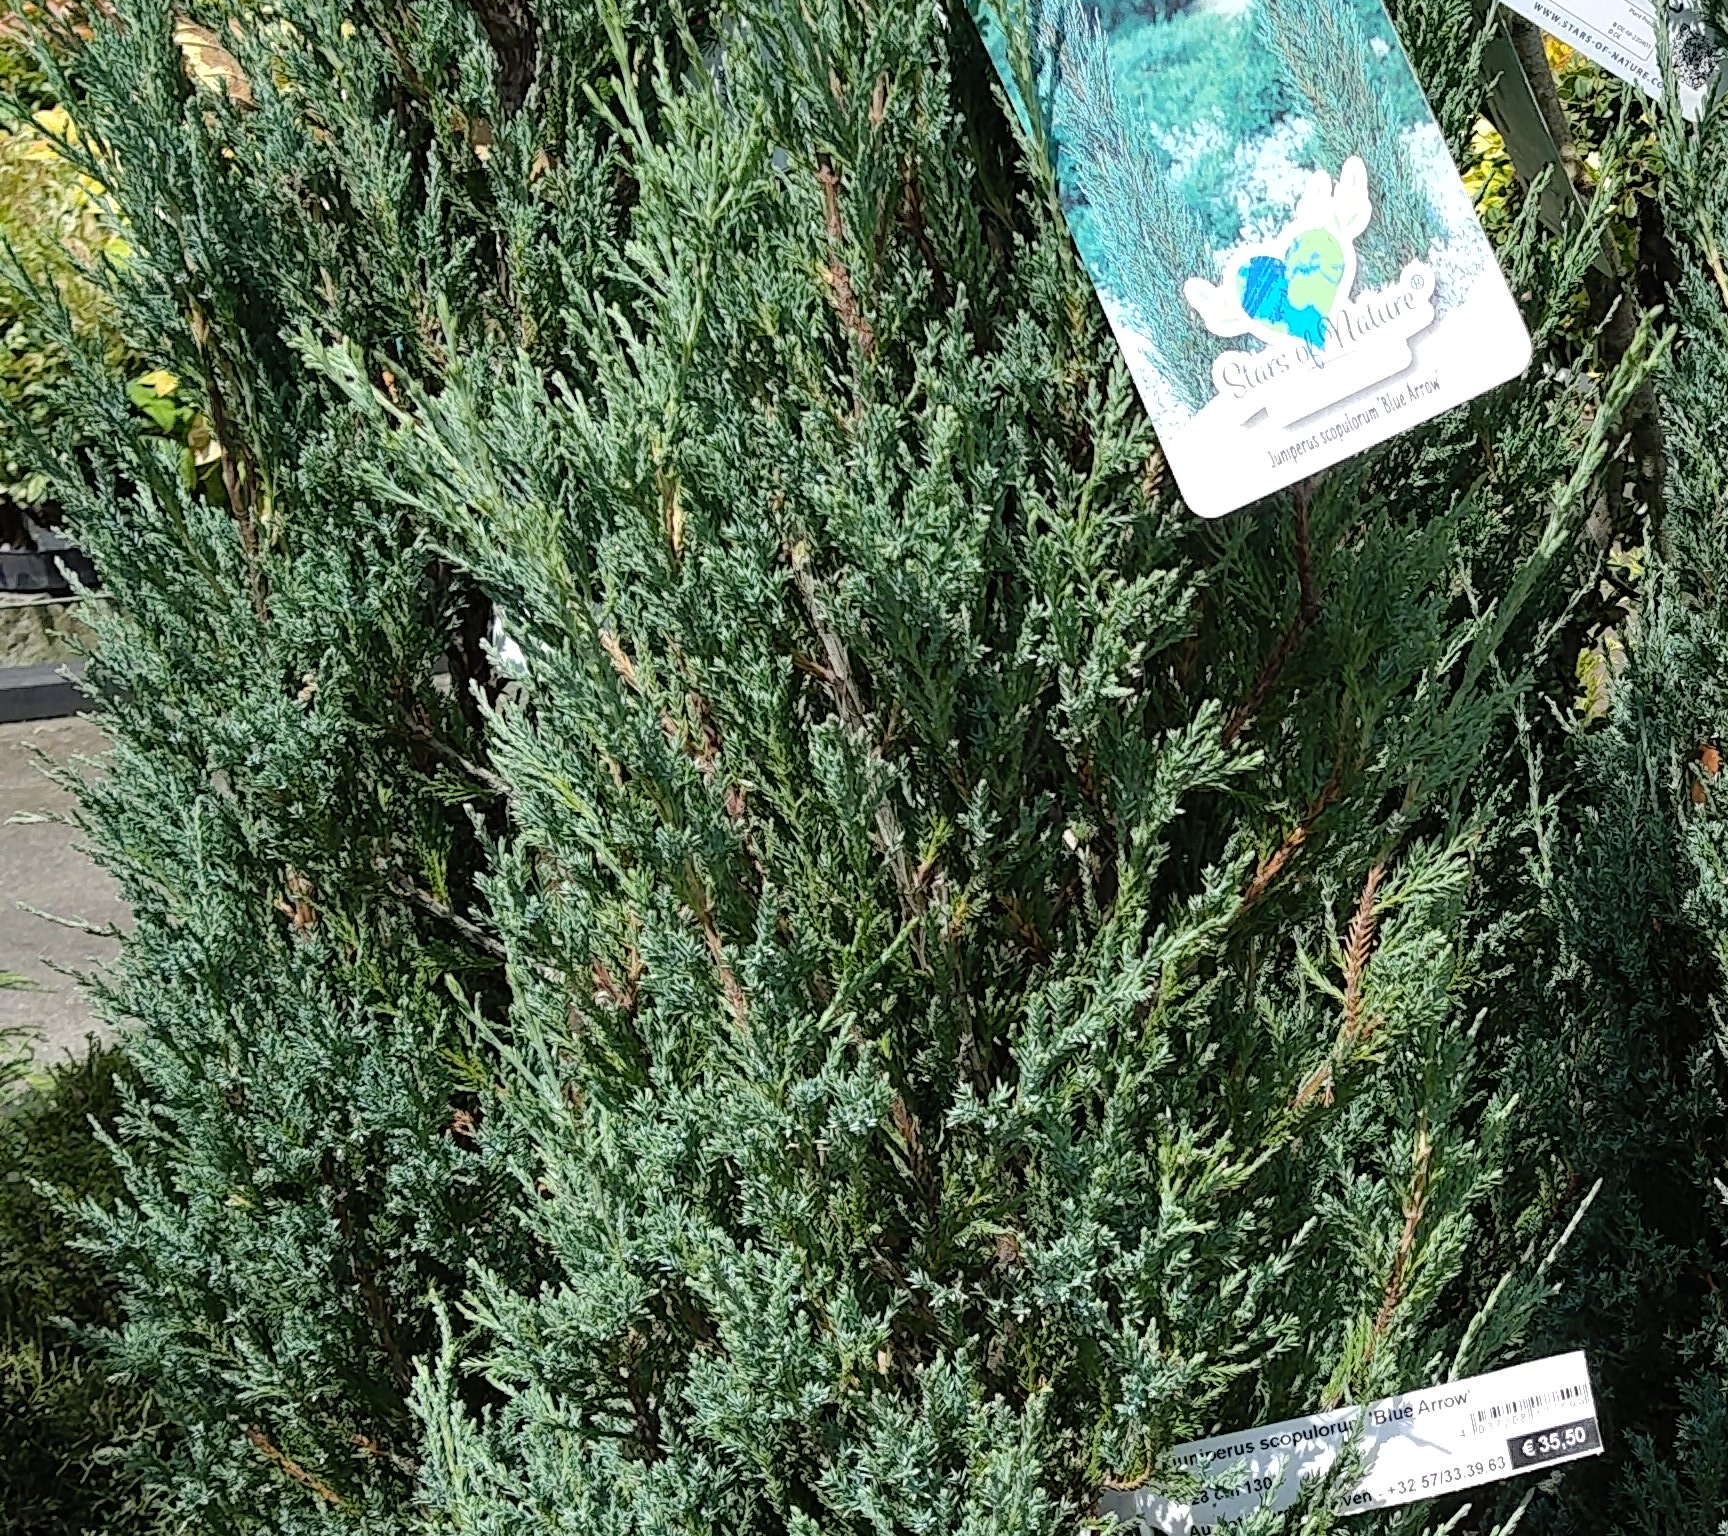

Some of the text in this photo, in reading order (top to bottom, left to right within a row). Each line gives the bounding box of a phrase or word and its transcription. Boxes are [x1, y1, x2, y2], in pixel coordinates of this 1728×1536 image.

[1533, 1, 1664, 89] WWW.STARS-OF-NATURE.CO
[1222, 353, 1290, 399] Stars
[1294, 329, 1325, 370] of
[1268, 435, 1320, 469] Juniperus
[1319, 406, 1380, 444] scopulorum
[1537, 1425, 1586, 1453] 35,50
[1244, 1476, 1273, 1495] 130
[1387, 1478, 1417, 1496] +32
[1421, 1455, 1506, 1489] 57/33.39.63
